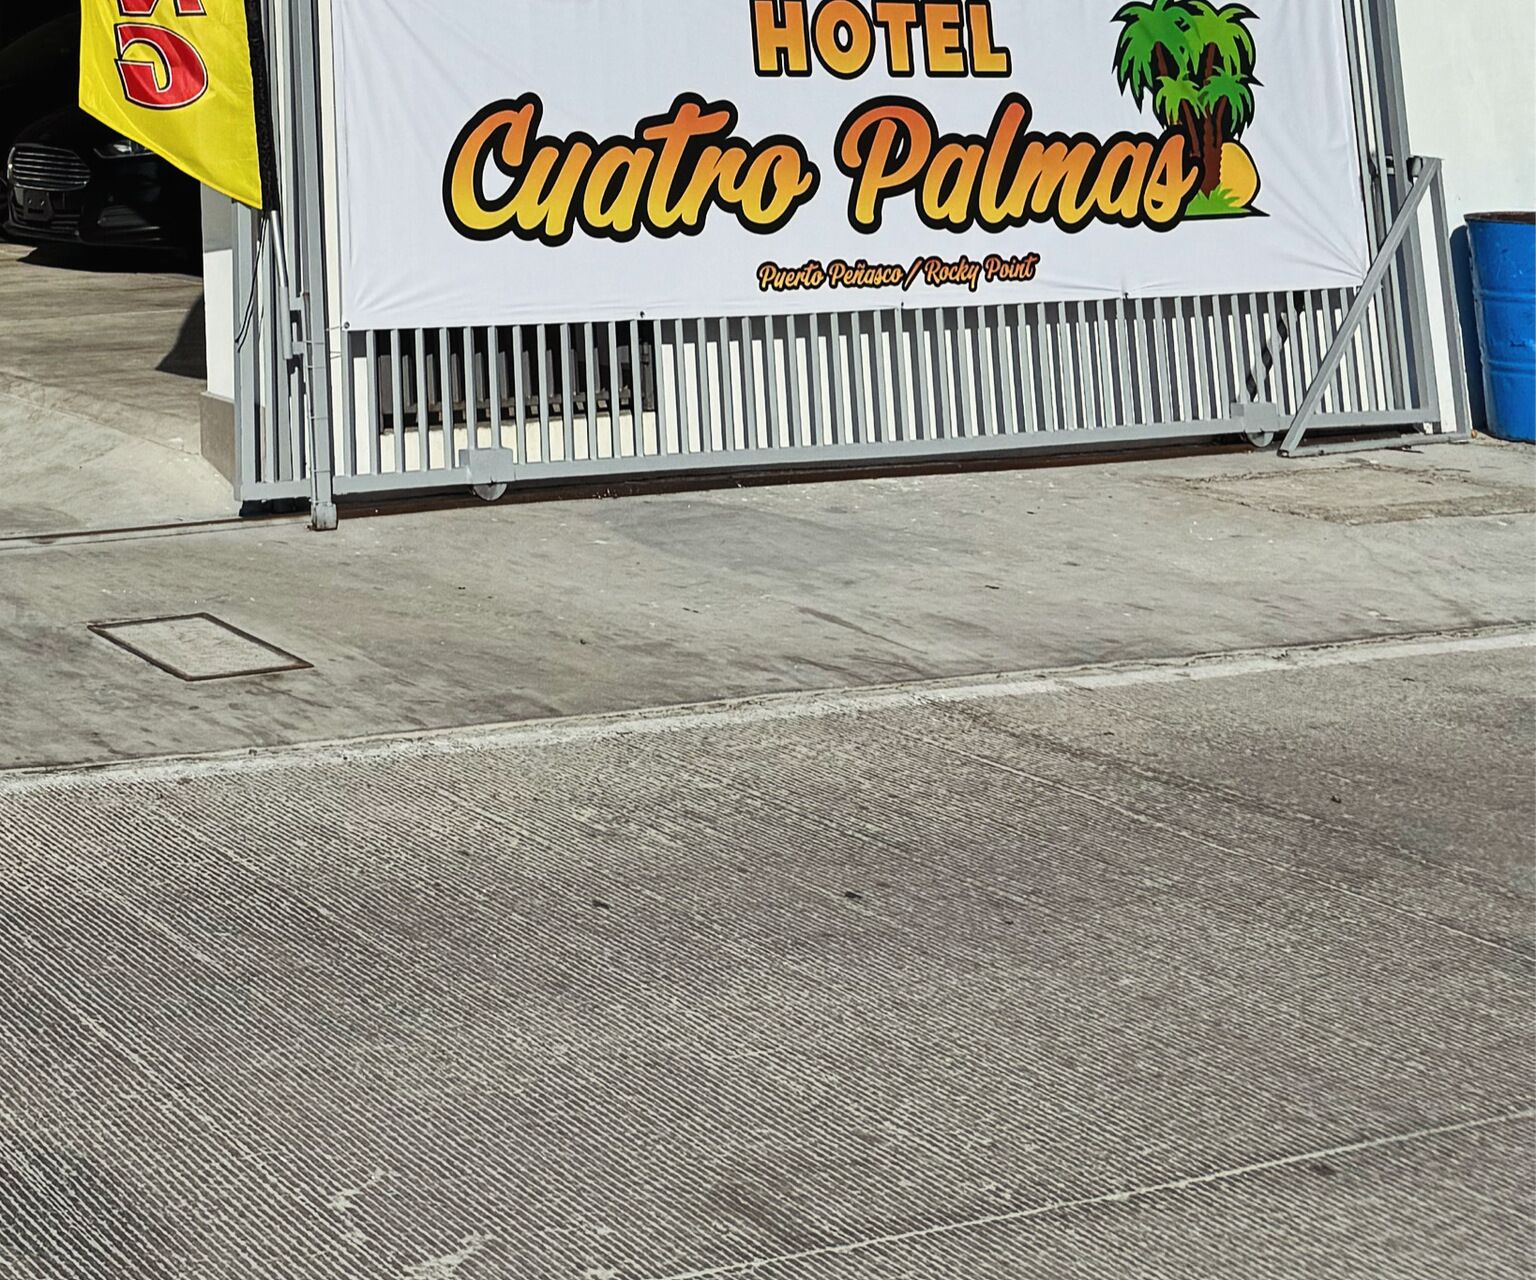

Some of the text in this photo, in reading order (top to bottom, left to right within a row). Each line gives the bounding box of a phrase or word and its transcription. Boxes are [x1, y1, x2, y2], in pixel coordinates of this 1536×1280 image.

[442, 92, 1205, 247] Cuatro Palmas
[757, 259, 826, 291] Puerto
[827, 258, 904, 290] Peñasco
[924, 255, 982, 292] Rocky
[983, 252, 1041, 282] Point
